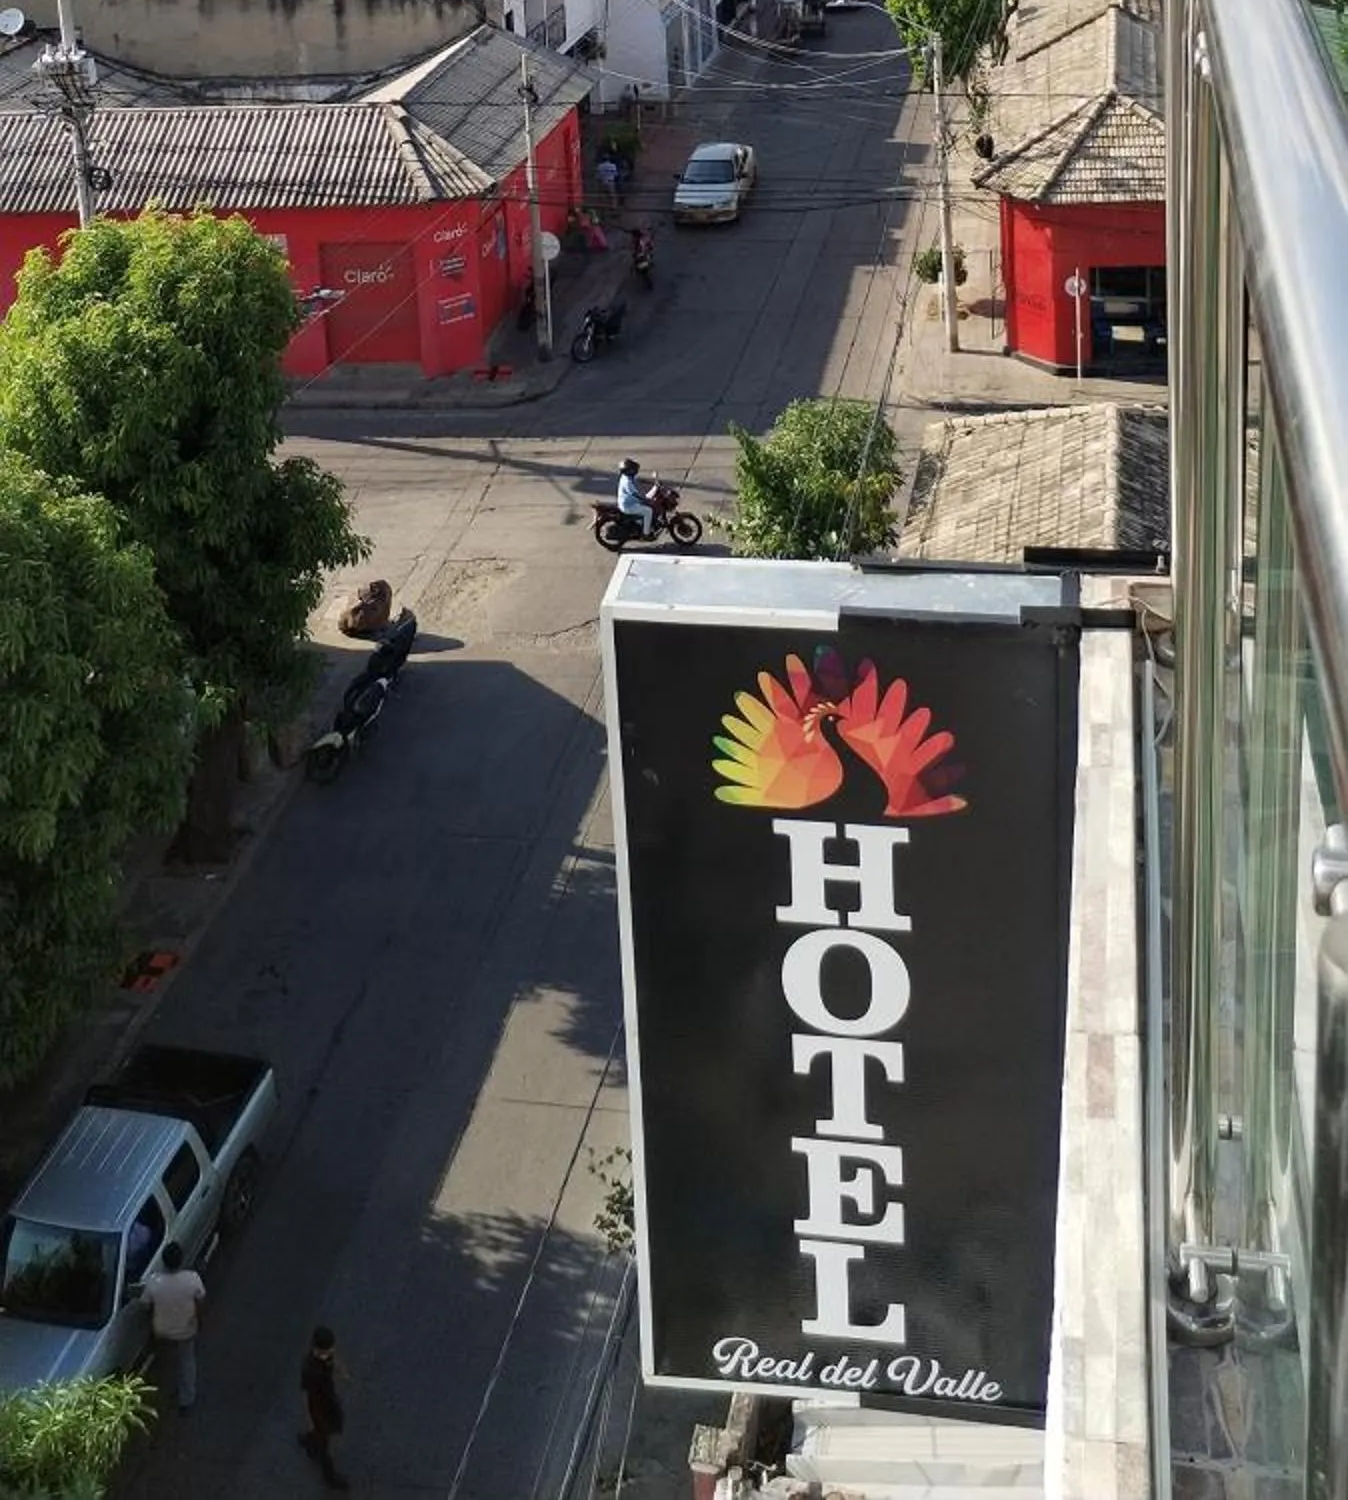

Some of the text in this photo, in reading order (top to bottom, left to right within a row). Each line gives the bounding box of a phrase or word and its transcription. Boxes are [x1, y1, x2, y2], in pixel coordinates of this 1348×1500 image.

[344, 263, 391, 283] Claro
[772, 819, 912, 1343] HOTEL
[712, 1337, 1003, 1401] Real del Valle
